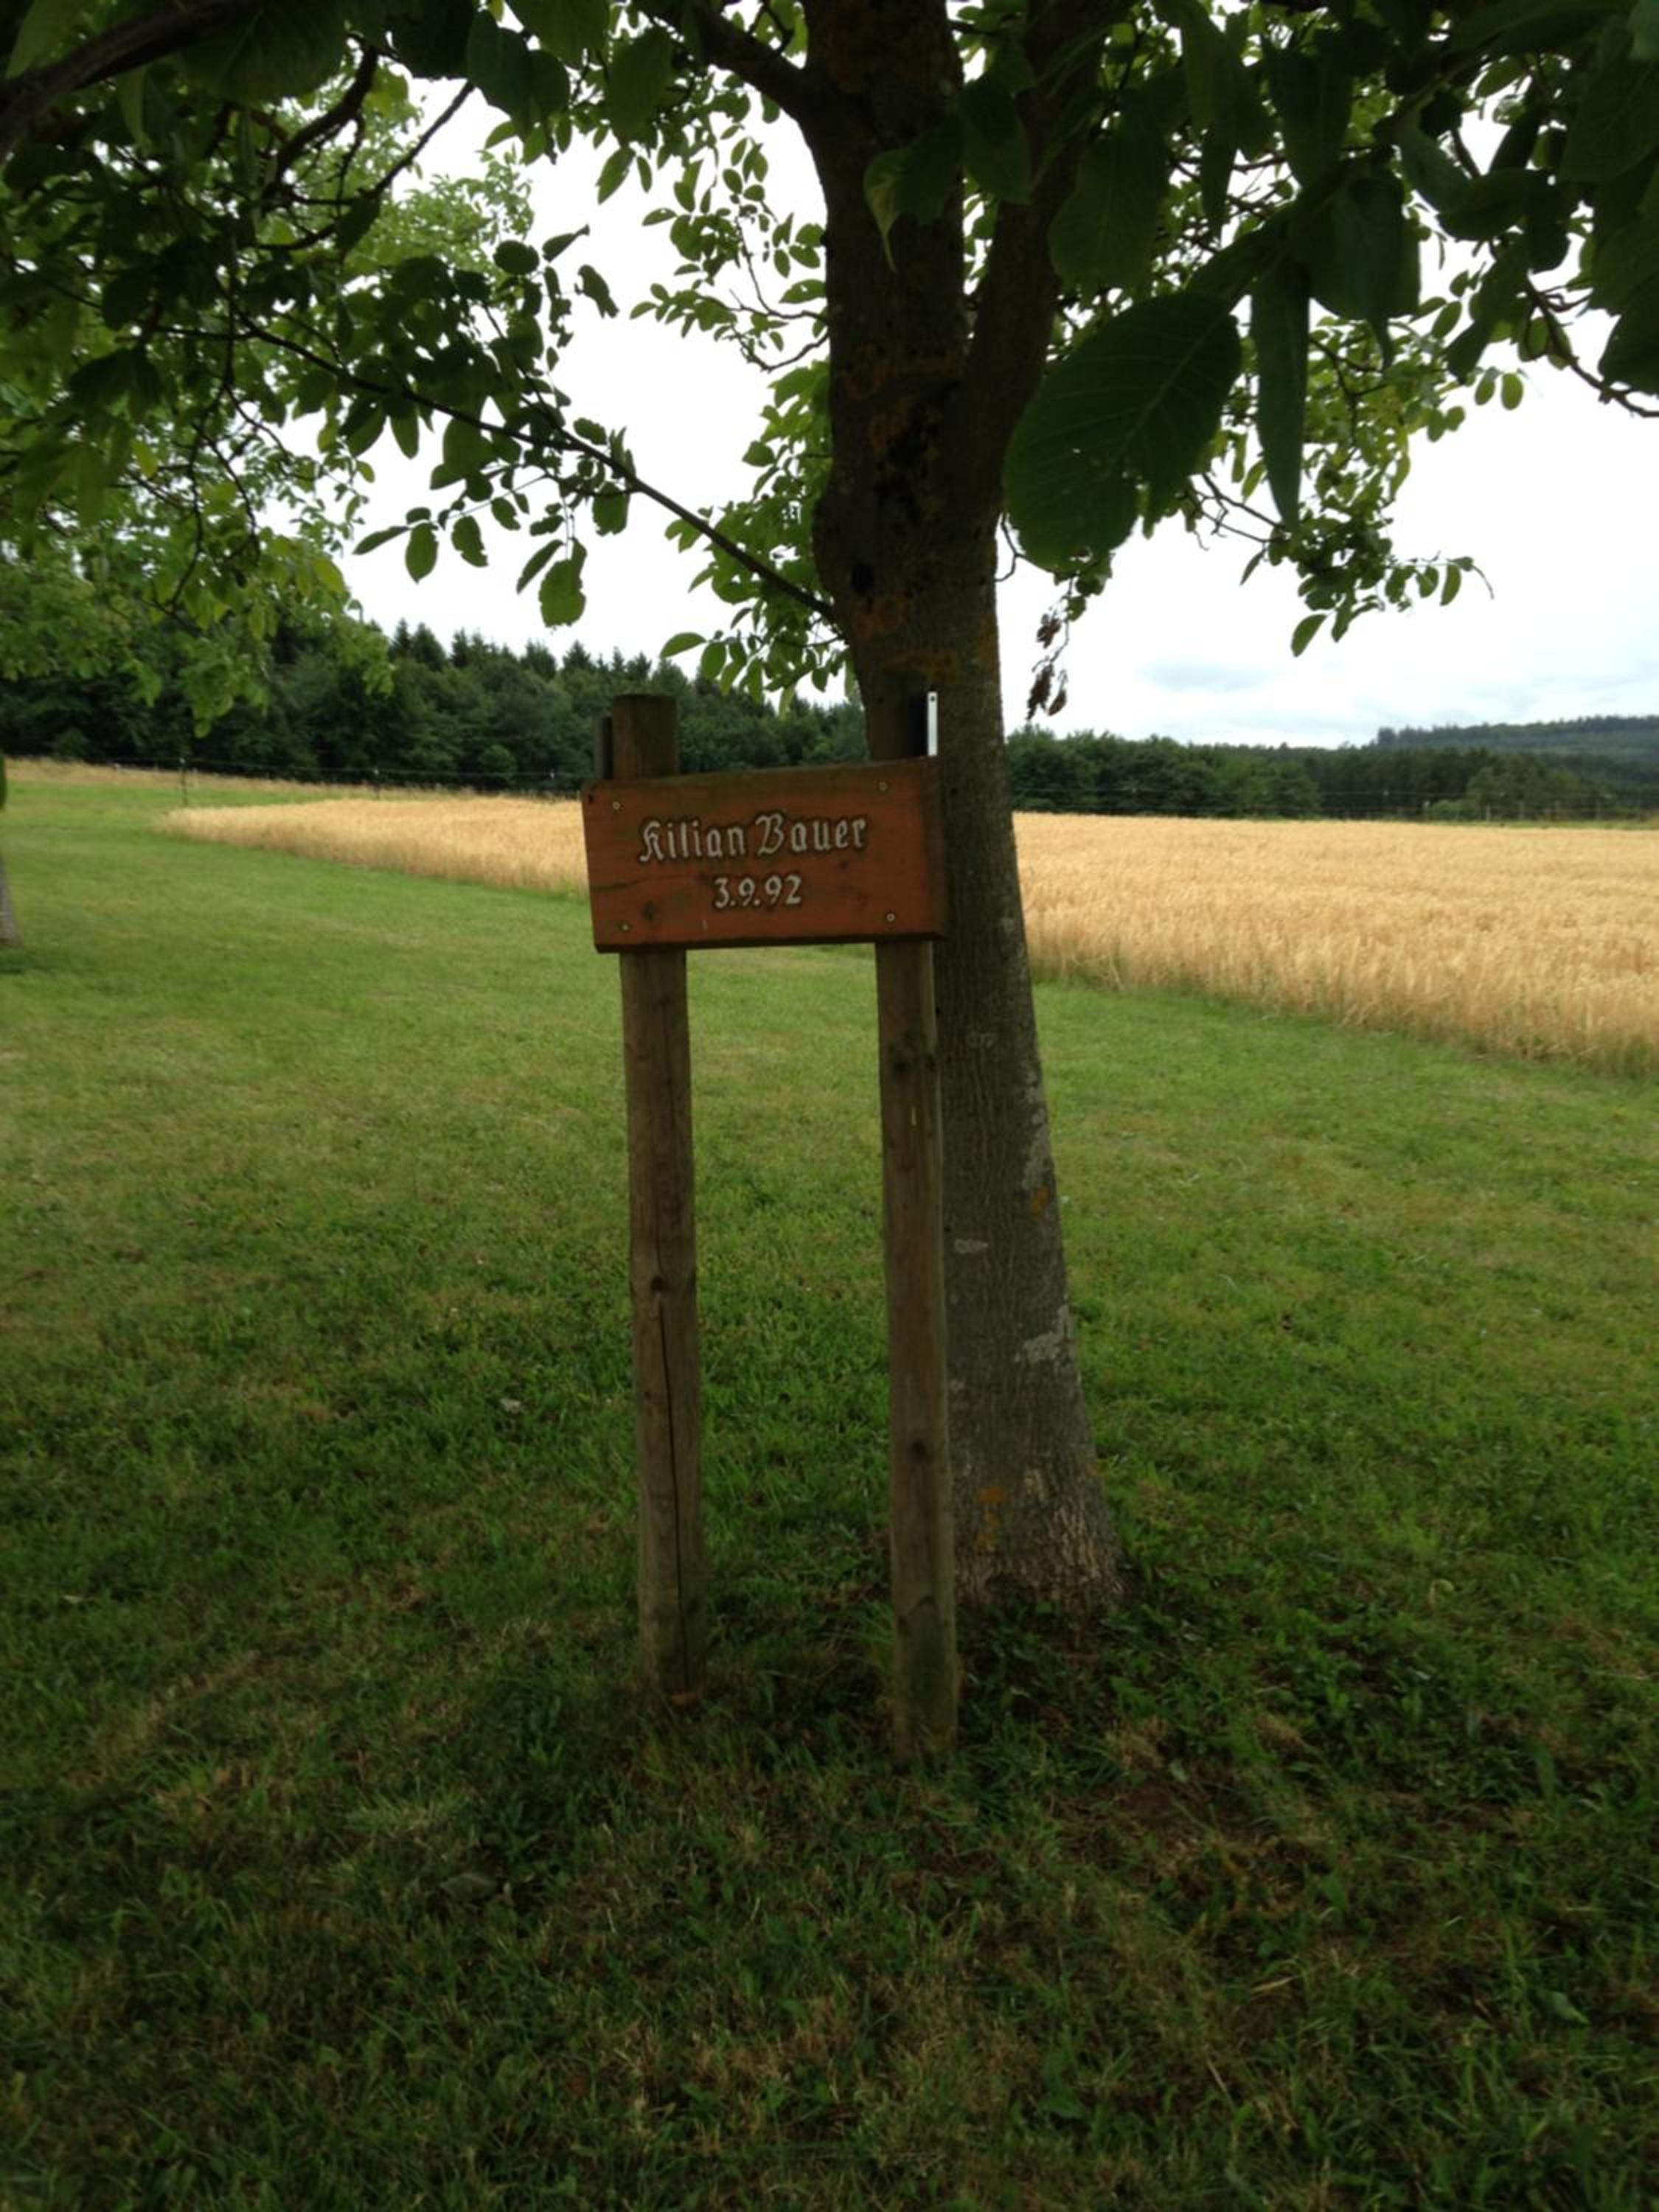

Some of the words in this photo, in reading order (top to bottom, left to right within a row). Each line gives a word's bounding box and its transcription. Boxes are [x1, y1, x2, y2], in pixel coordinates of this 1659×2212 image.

[639, 820, 746, 862] Kilian
[754, 813, 867, 855] Bauer
[714, 874, 802, 908] 3.9.92
